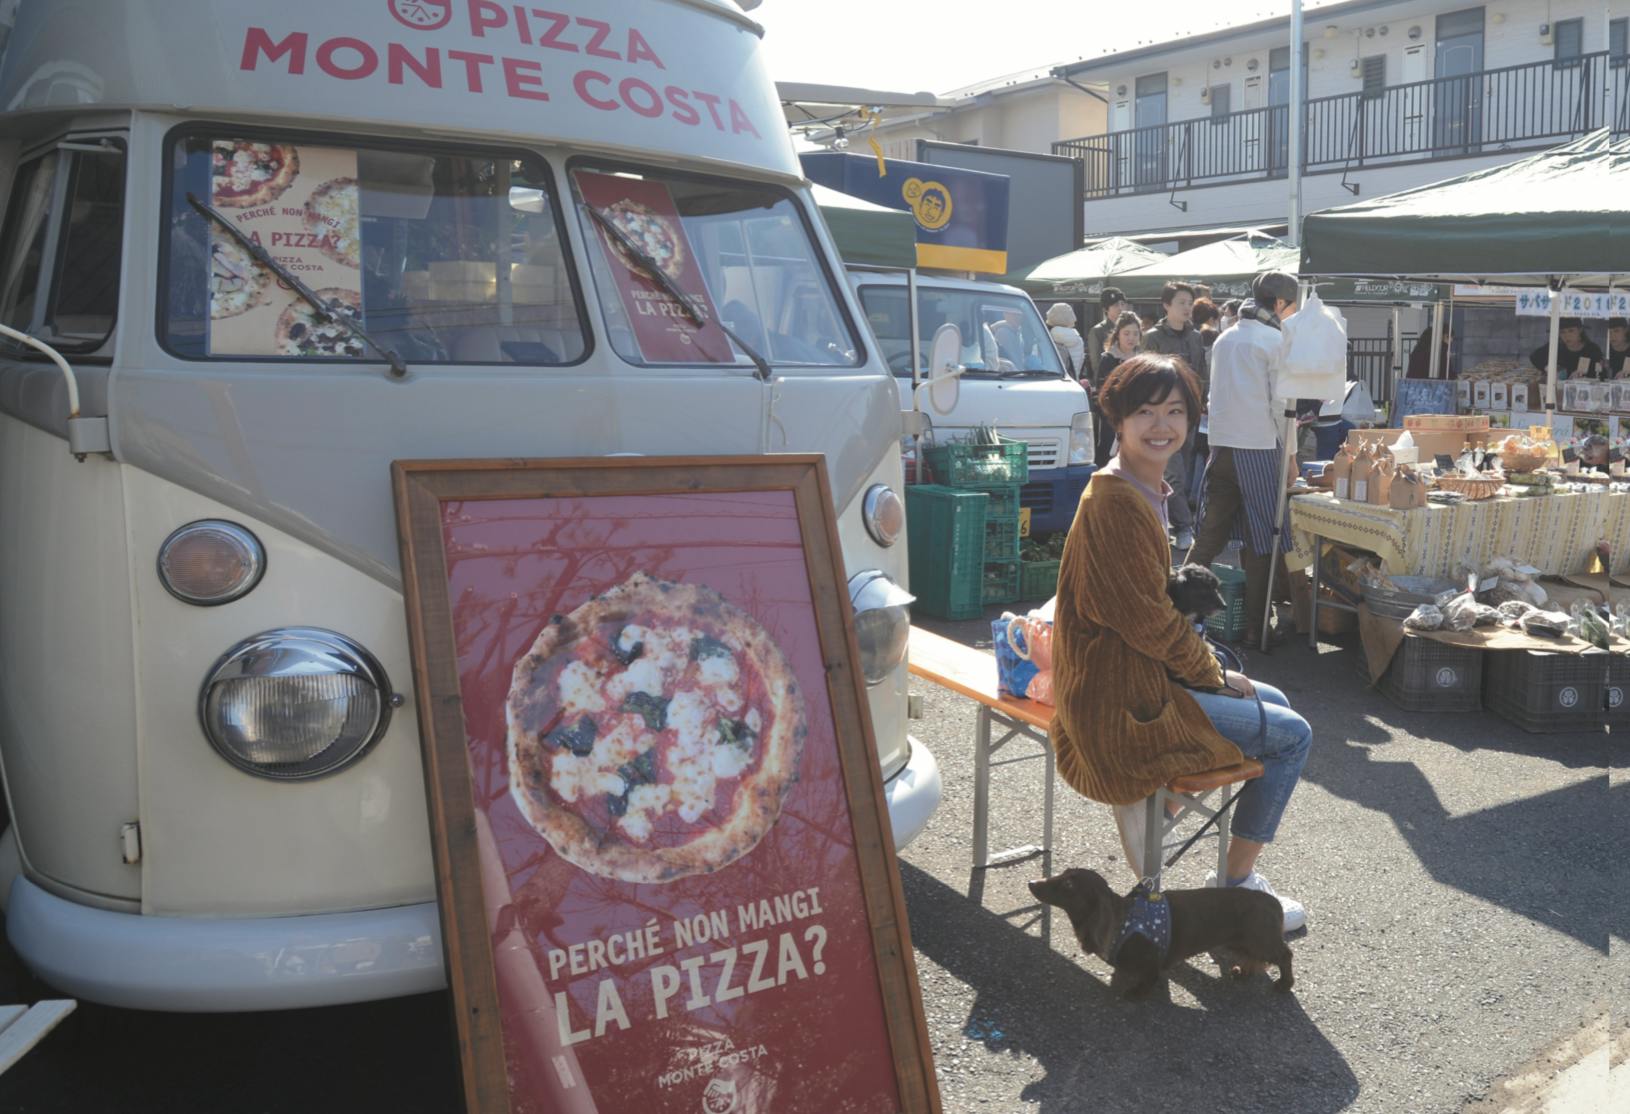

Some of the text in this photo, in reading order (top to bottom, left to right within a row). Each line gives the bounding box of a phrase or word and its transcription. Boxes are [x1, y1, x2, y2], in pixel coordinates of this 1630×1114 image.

[467, 0, 666, 70] PIZZA
[240, 27, 763, 140] MONTE COSTA
[236, 206, 276, 223] PERCHÉ
[282, 207, 303, 217] NON
[271, 231, 341, 251] PIZZA?
[290, 264, 324, 272] COSTA
[635, 300, 657, 316] LA
[548, 887, 823, 980] PERCHÉ NON MANGI
[554, 924, 828, 1047] LA PIZZA?
[658, 1044, 768, 1088] MONTE COSTA
[686, 1040, 735, 1062] PIZZA
